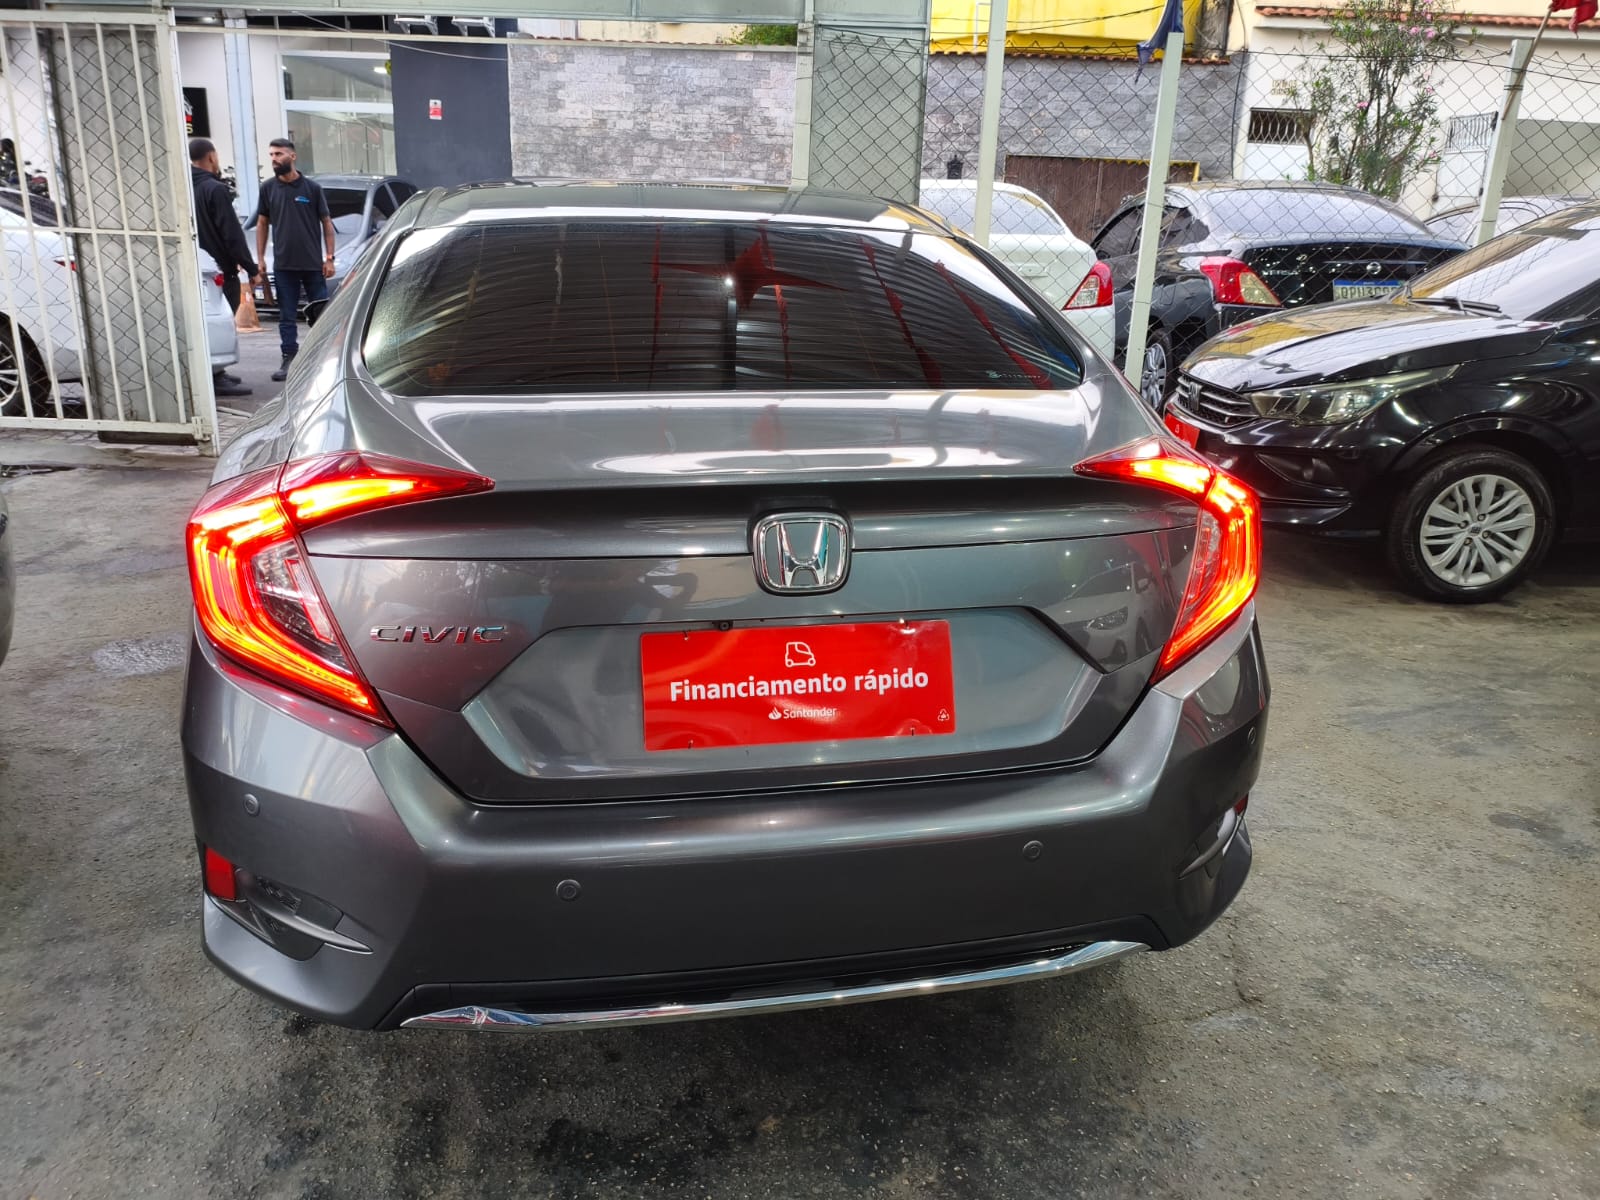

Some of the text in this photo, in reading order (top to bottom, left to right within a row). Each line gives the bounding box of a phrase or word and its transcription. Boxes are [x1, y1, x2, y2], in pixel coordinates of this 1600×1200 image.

[369, 625, 506, 643] CIVIC
[670, 667, 929, 702] Financiamento rápido
[783, 706, 837, 718] Santander
